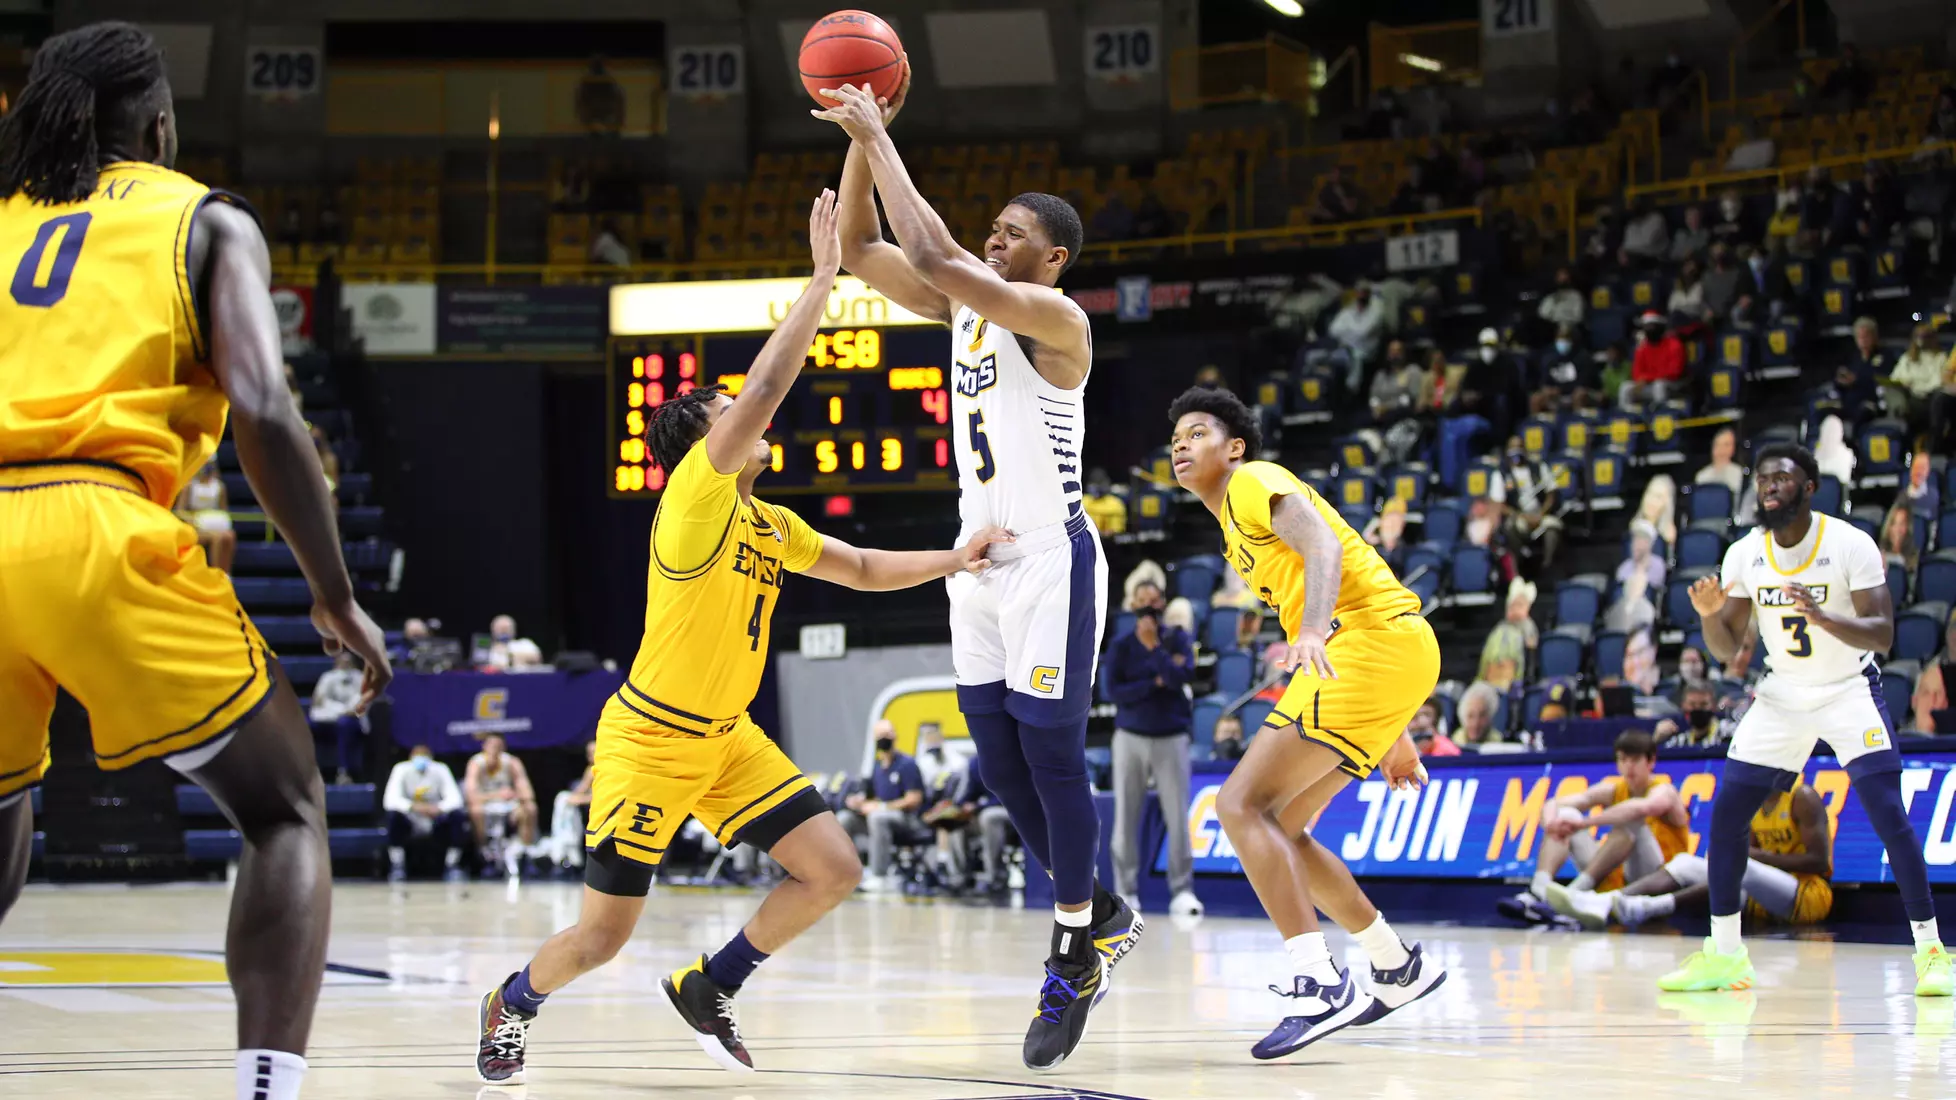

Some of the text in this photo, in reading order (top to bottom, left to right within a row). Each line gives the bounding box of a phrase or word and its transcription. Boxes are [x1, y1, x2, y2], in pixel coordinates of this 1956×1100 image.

[1094, 31, 1150, 70] 210
[251, 53, 315, 88] 209
[679, 53, 737, 87] 210
[10, 211, 93, 308] 0
[1398, 235, 1443, 268] 112
[955, 353, 997, 398] MOS
[829, 396, 842, 424] 1
[921, 389, 948, 424] 4
[816, 438, 902, 472] 5 1 3
[935, 439, 948, 467] 1
[968, 410, 996, 484] 5
[747, 593, 766, 652] 4
[1781, 614, 1813, 659] 3
[1029, 665, 1060, 694] C
[1863, 727, 1884, 748] C
[628, 802, 664, 837] E
[1341, 778, 1479, 862] JOIN
